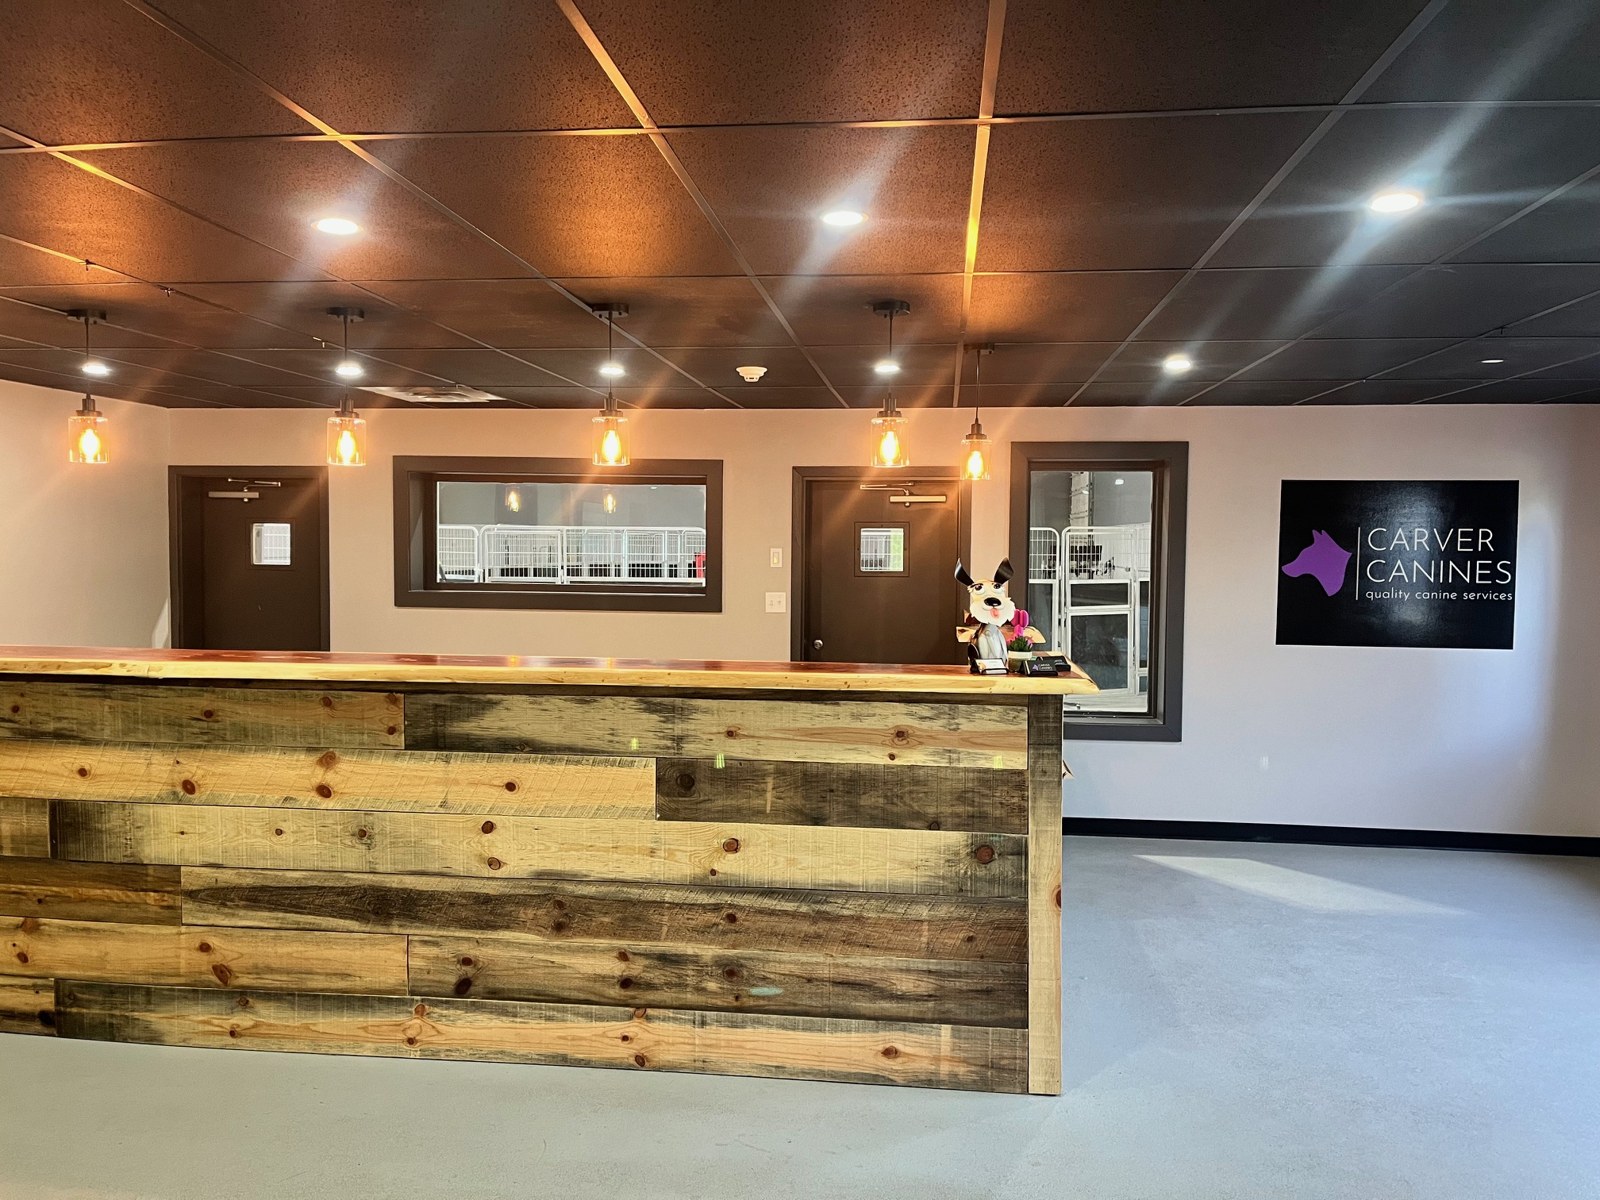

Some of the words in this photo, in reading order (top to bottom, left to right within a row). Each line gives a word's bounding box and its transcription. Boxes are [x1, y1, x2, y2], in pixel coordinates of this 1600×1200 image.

[1367, 527, 1494, 552] CARVER
[1366, 559, 1512, 584] CANINES
[1365, 587, 1410, 601] quality
[1415, 589, 1458, 600] canine
[1462, 590, 1513, 601] services
